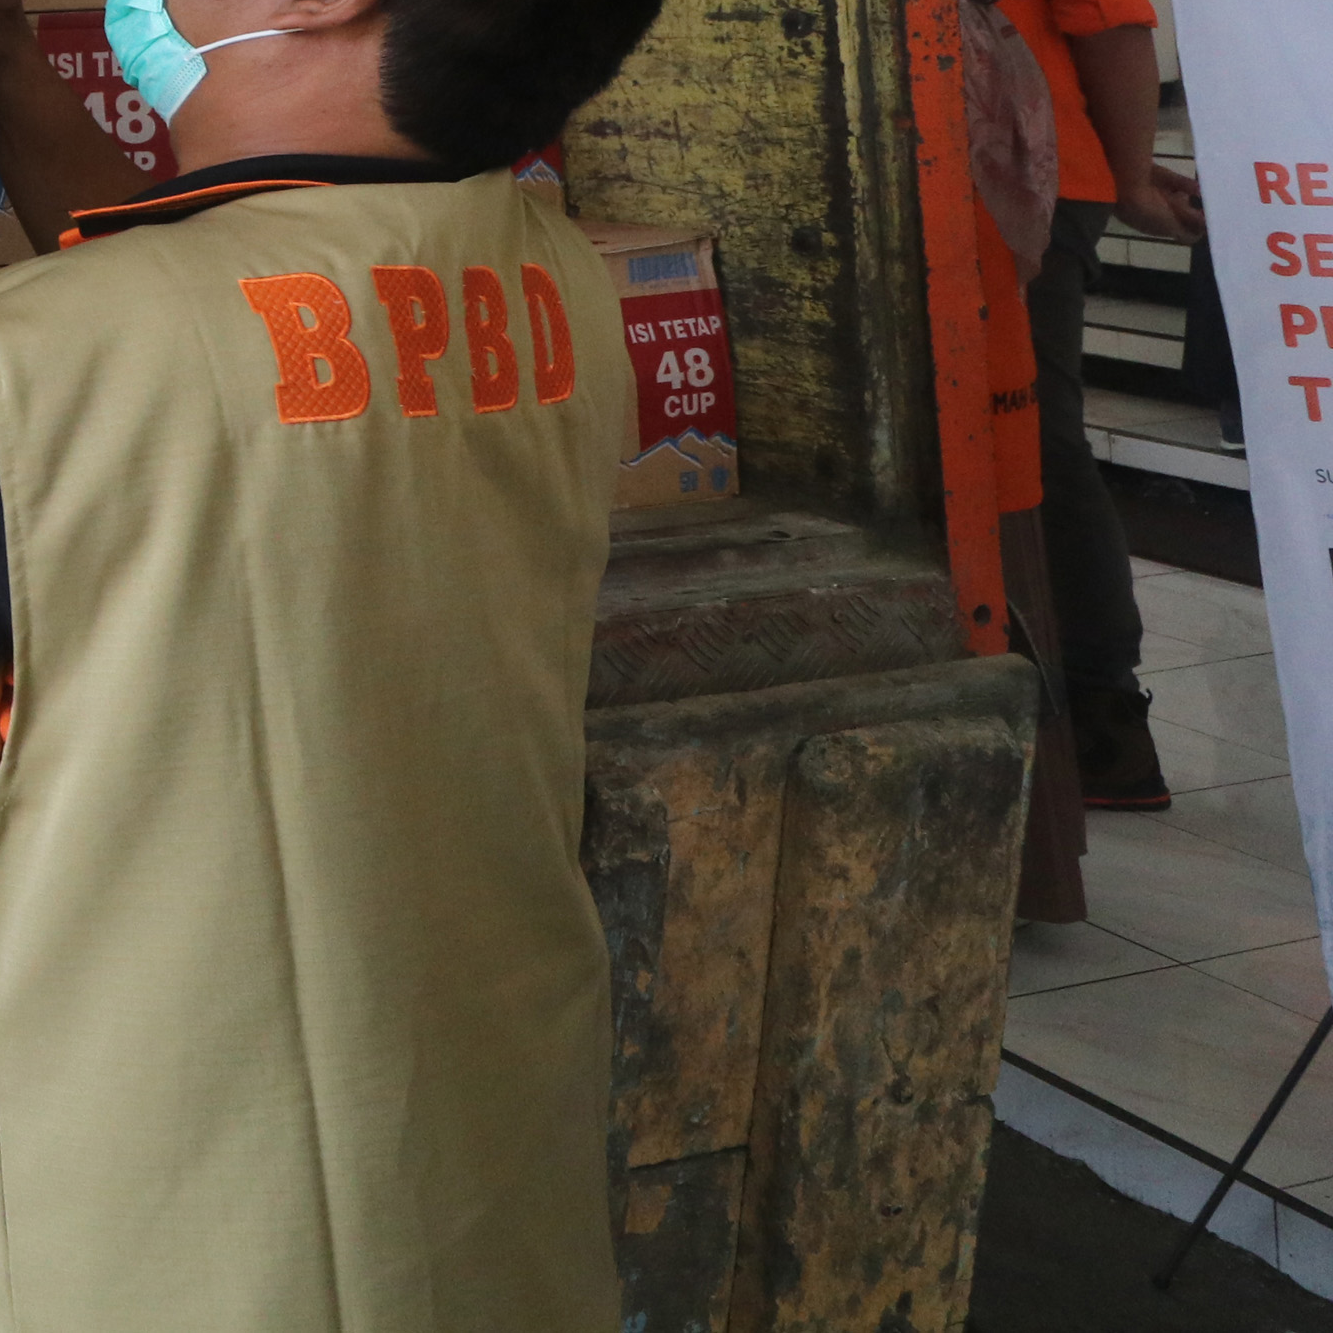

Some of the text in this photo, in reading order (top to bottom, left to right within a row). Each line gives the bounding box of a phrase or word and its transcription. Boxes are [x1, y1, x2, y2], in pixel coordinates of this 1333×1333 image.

[237, 262, 576, 425] BPBD
[628, 315, 723, 345] ISI TETAP
[656, 347, 715, 390] 48
[664, 392, 716, 419] CUP
